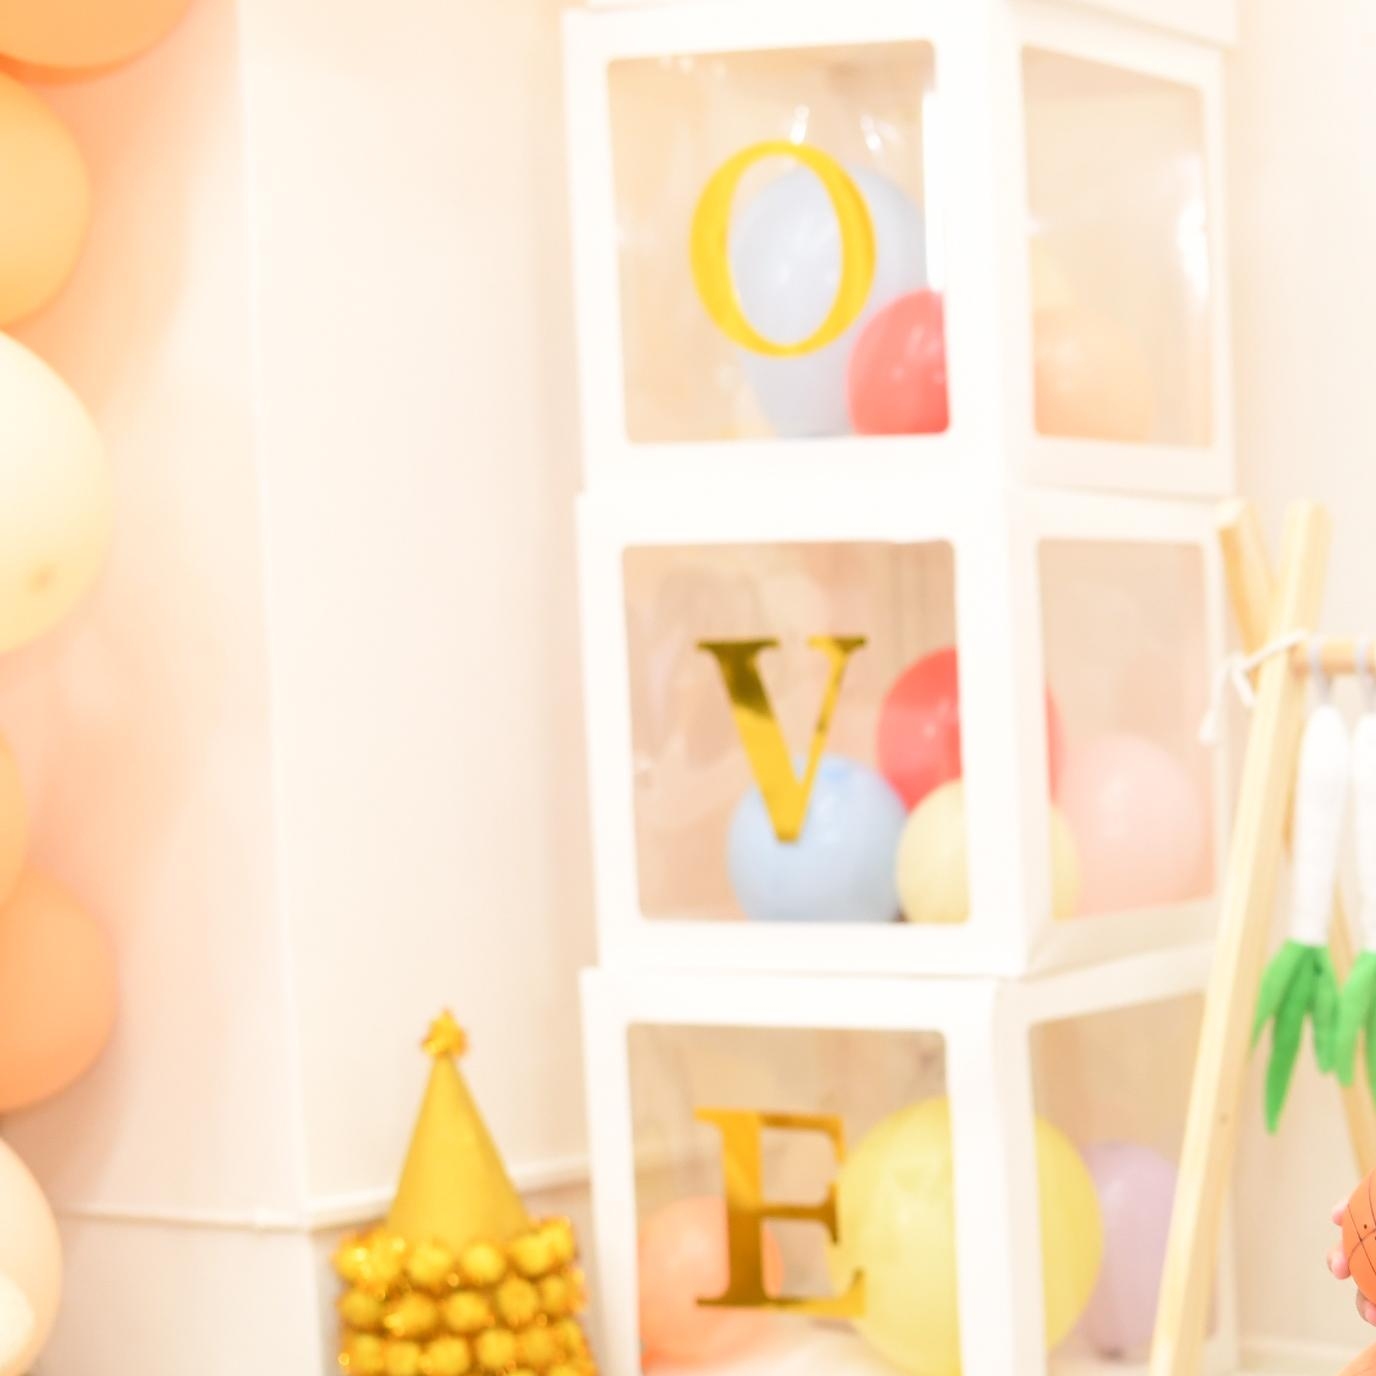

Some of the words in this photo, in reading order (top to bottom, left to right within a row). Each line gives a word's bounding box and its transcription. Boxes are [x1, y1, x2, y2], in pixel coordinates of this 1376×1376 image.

[690, 141, 876, 356] O
[698, 637, 867, 843] V
[695, 1107, 866, 1317] E
